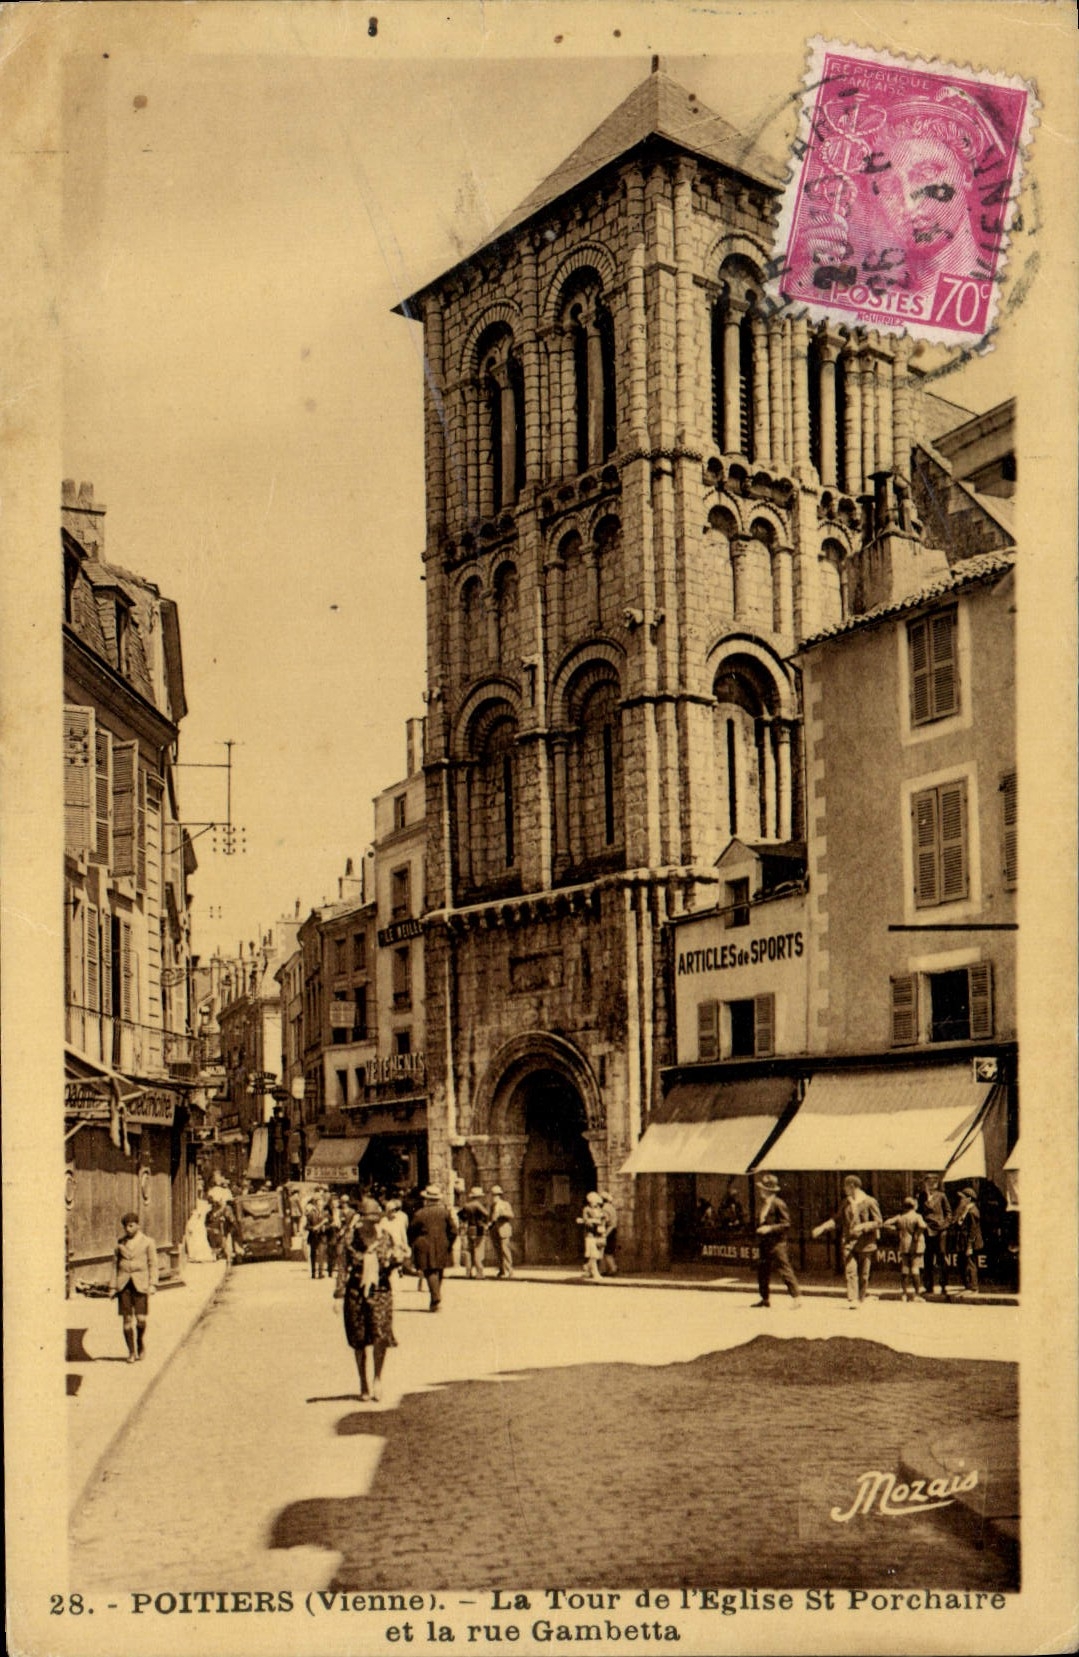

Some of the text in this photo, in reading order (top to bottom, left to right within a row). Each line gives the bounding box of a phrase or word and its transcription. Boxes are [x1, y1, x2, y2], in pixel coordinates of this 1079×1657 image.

[831, 279, 925, 317] POSTES
[678, 931, 804, 976] ARTICLES de SPORTS
[702, 1244, 737, 1258] ARTICLES
